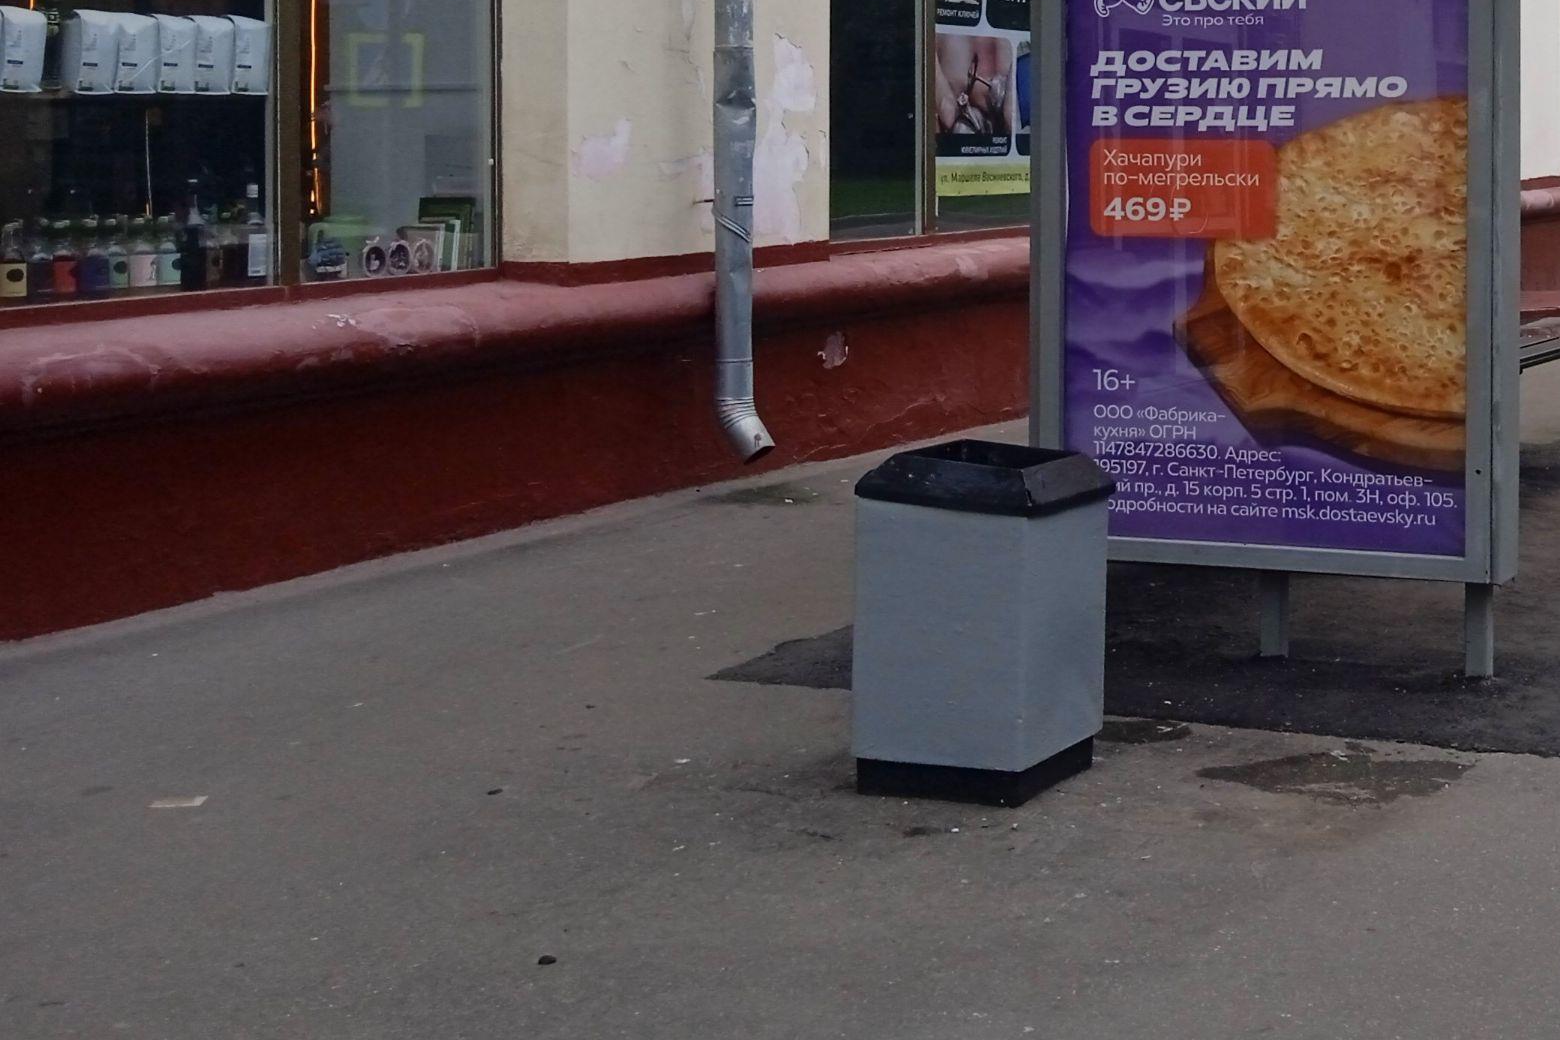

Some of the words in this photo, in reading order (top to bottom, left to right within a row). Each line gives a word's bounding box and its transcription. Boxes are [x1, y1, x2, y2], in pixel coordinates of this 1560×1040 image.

[1162, 15, 1191, 26] Это
[1194, 17, 1223, 28] про
[1227, 14, 1264, 26] тебя
[1090, 49, 1323, 76] ДОСТАВИМ
[1091, 77, 1251, 99] ГРУЗИЮ
[1257, 76, 1408, 98] ПРЯМО
[1092, 106, 1118, 127] В
[1124, 105, 1295, 132] СЕРДЦЕ
[1103, 149, 1202, 171] Хачапури
[1103, 172, 1260, 190] по-мегрельски
[1093, 369, 1135, 391] 16+
[1093, 404, 1133, 419] ООО
[1137, 406, 1226, 424] «Фабрика-
[1094, 426, 1146, 440] кухня»
[1150, 424, 1197, 440] ОГРН
[1094, 440, 1221, 460] 1147847286630.
[1225, 446, 1282, 464] Адрес:
[1153, 464, 1164, 476] г.
[1167, 462, 1318, 486] Санкт-Петербург,
[1321, 468, 1433, 488] Кондратьев-
[1134, 484, 1162, 497] пр.,
[1165, 483, 1180, 497] д.
[1184, 481, 1200, 495] 15
[1203, 485, 1247, 500] корп.
[1251, 484, 1262, 498] 5
[1265, 488, 1297, 503] стр.
[1300, 487, 1311, 502] 1,
[1314, 491, 1352, 503] пом.
[1387, 491, 1420, 509] оф.
[1424, 492, 1458, 508] 105.
[1108, 498, 1203, 514] одробности
[1207, 504, 1227, 515] на
[1230, 503, 1278, 518] сайте
[1282, 506, 1436, 528] msk.dostaevsky.ru
